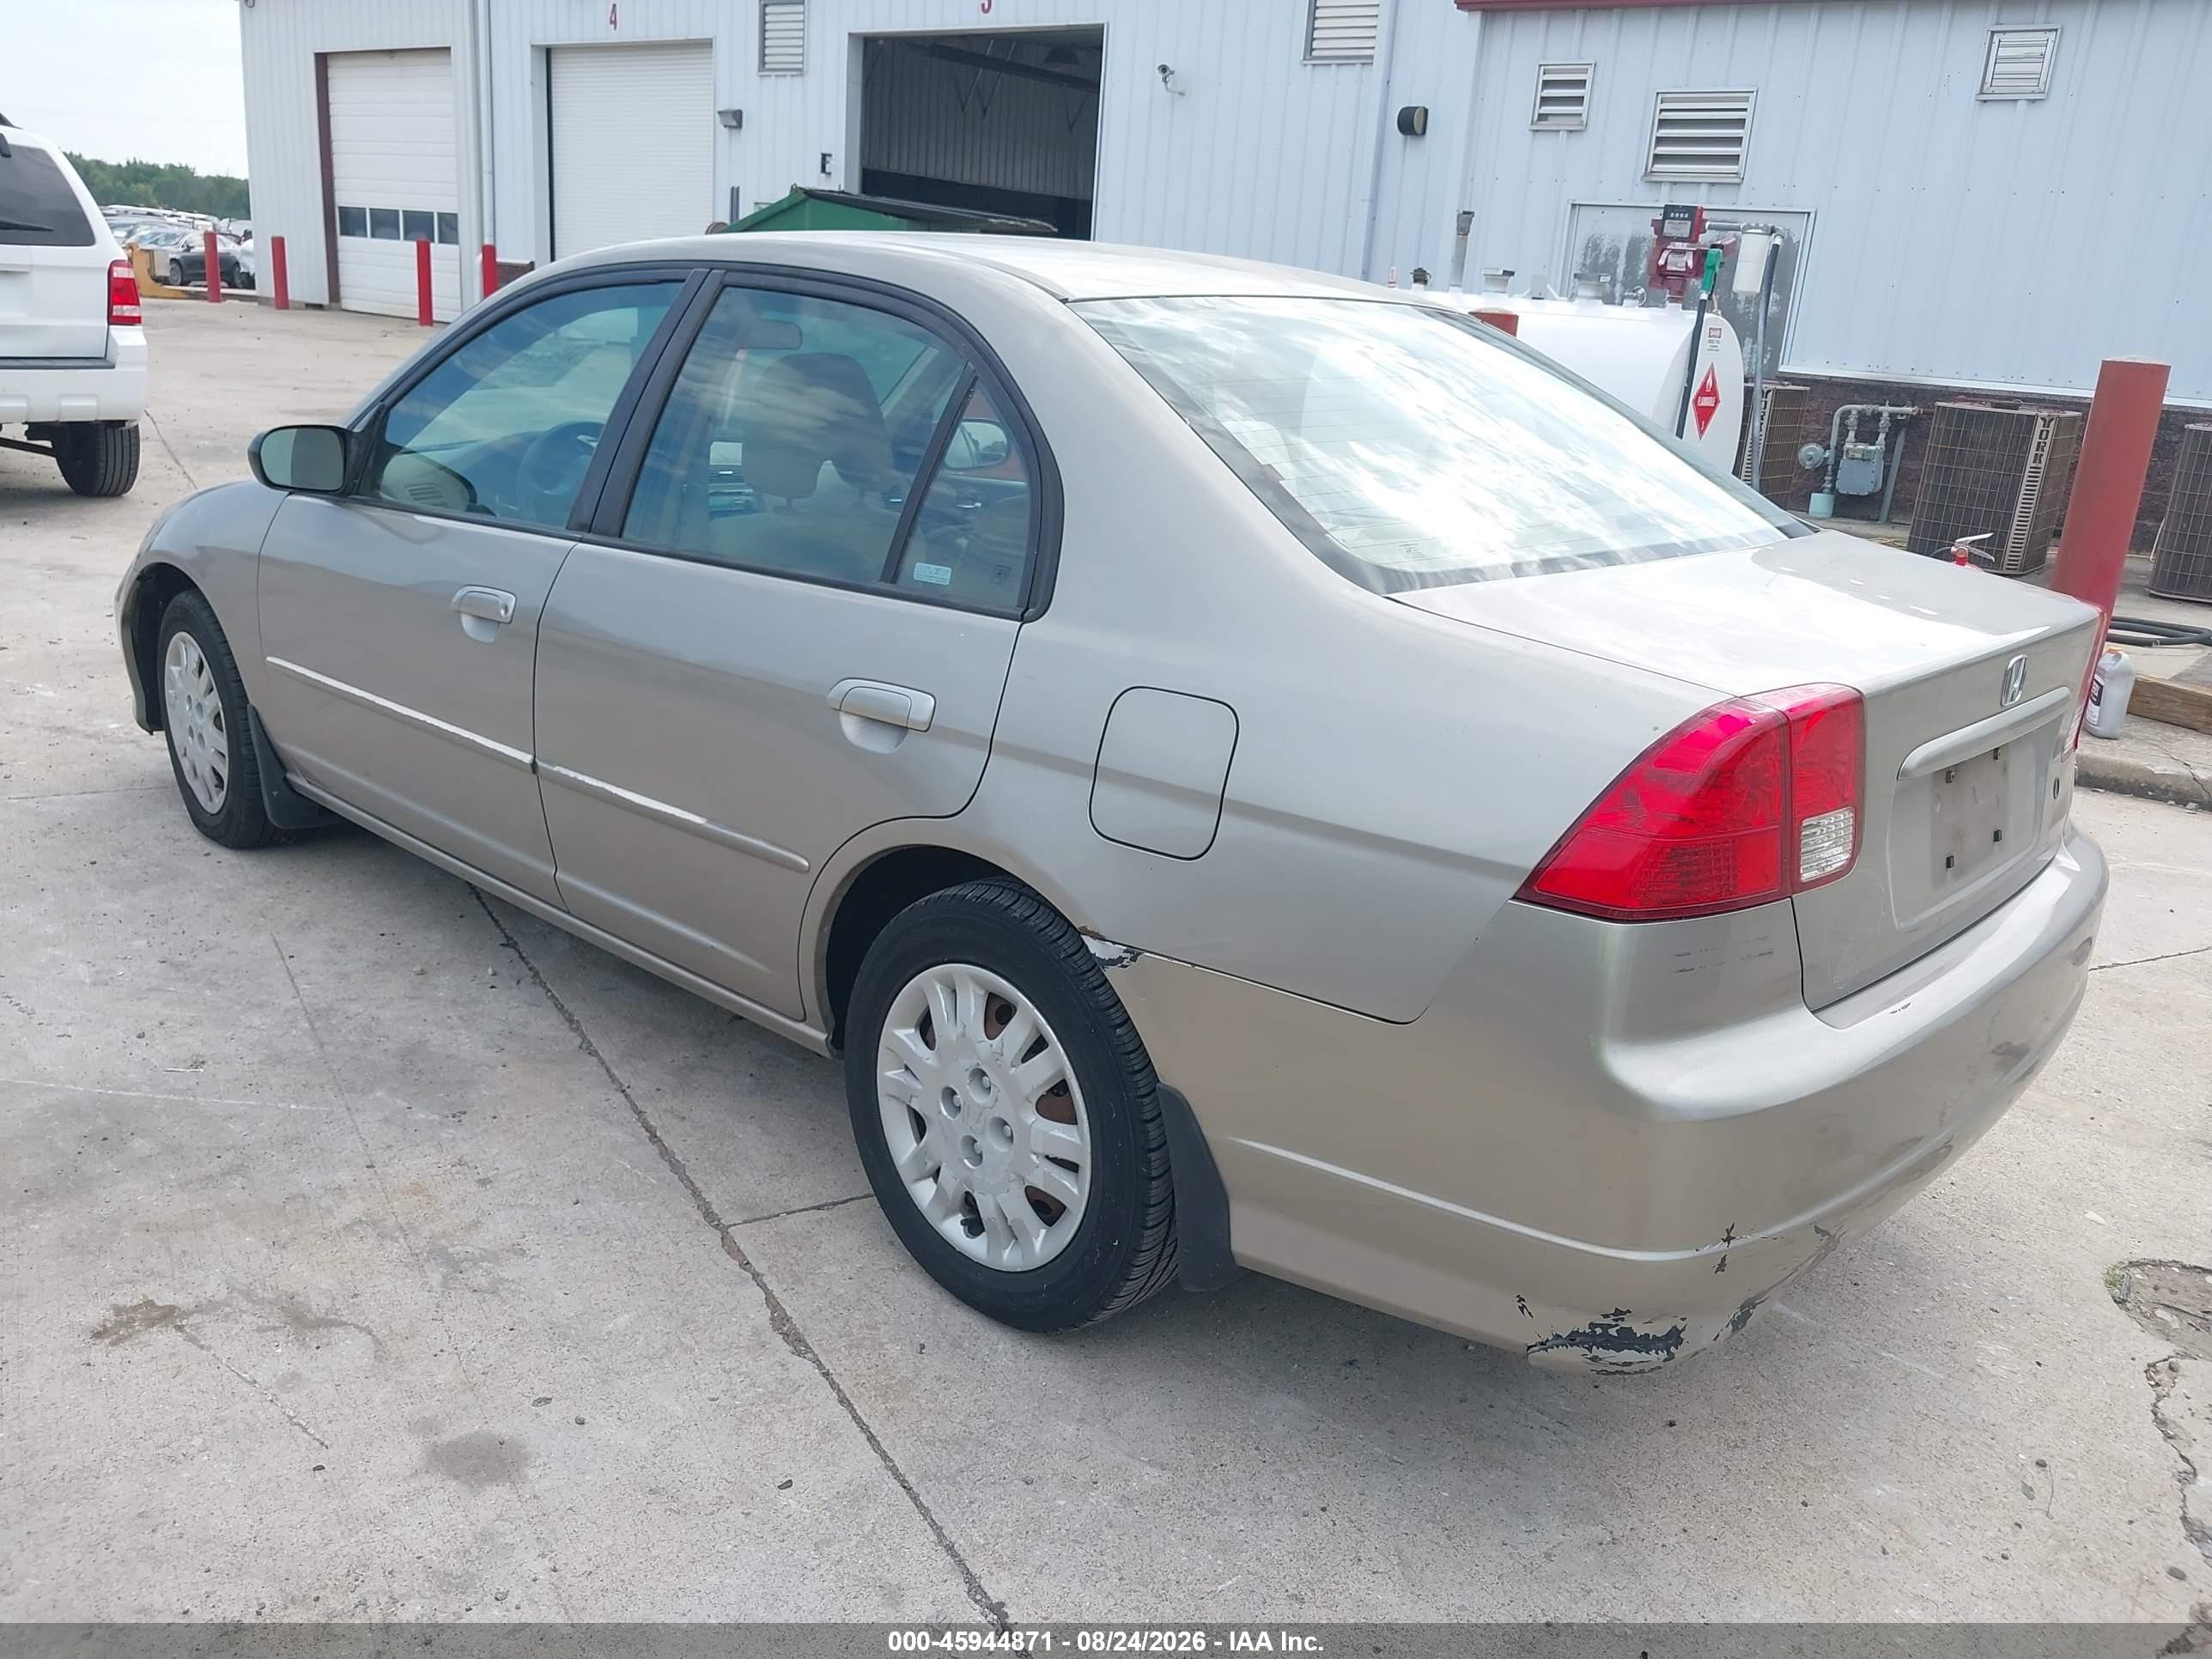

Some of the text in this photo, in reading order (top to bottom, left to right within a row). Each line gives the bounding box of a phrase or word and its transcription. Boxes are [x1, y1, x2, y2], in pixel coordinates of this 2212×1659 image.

[609, 3, 617, 31] 4
[821, 153, 833, 175] E
[2032, 416, 2056, 465] YORK
